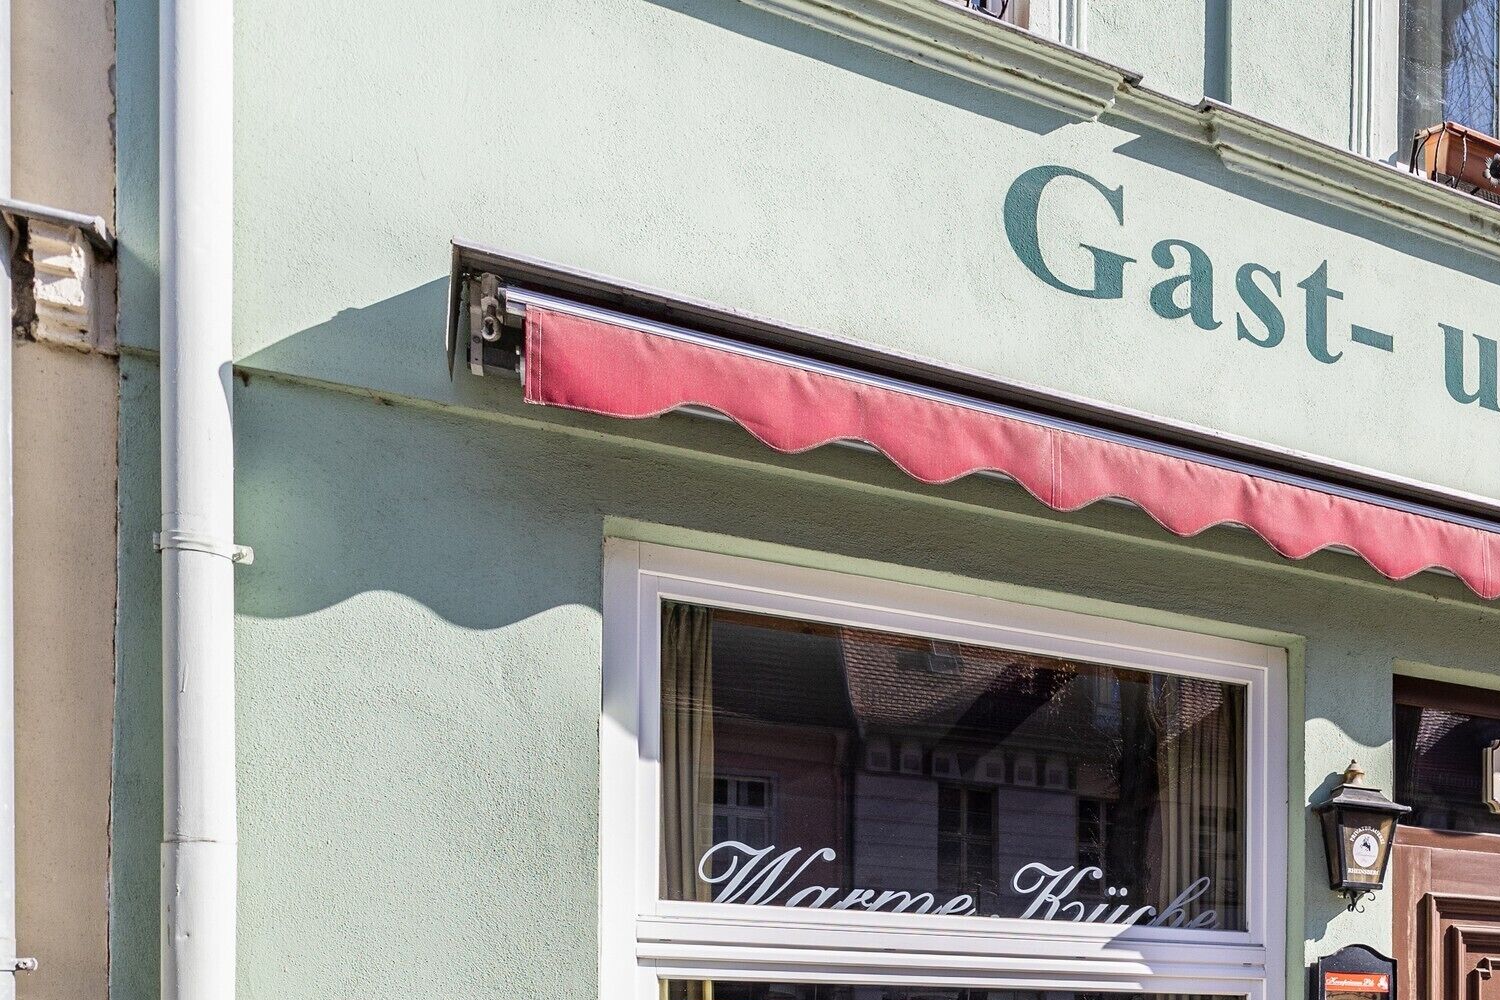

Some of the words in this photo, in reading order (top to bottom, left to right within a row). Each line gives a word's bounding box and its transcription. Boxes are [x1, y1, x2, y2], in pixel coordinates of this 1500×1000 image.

[1003, 164, 1393, 364] Gast-
[697, 839, 976, 917] Warme
[1012, 861, 1221, 930] Küche
